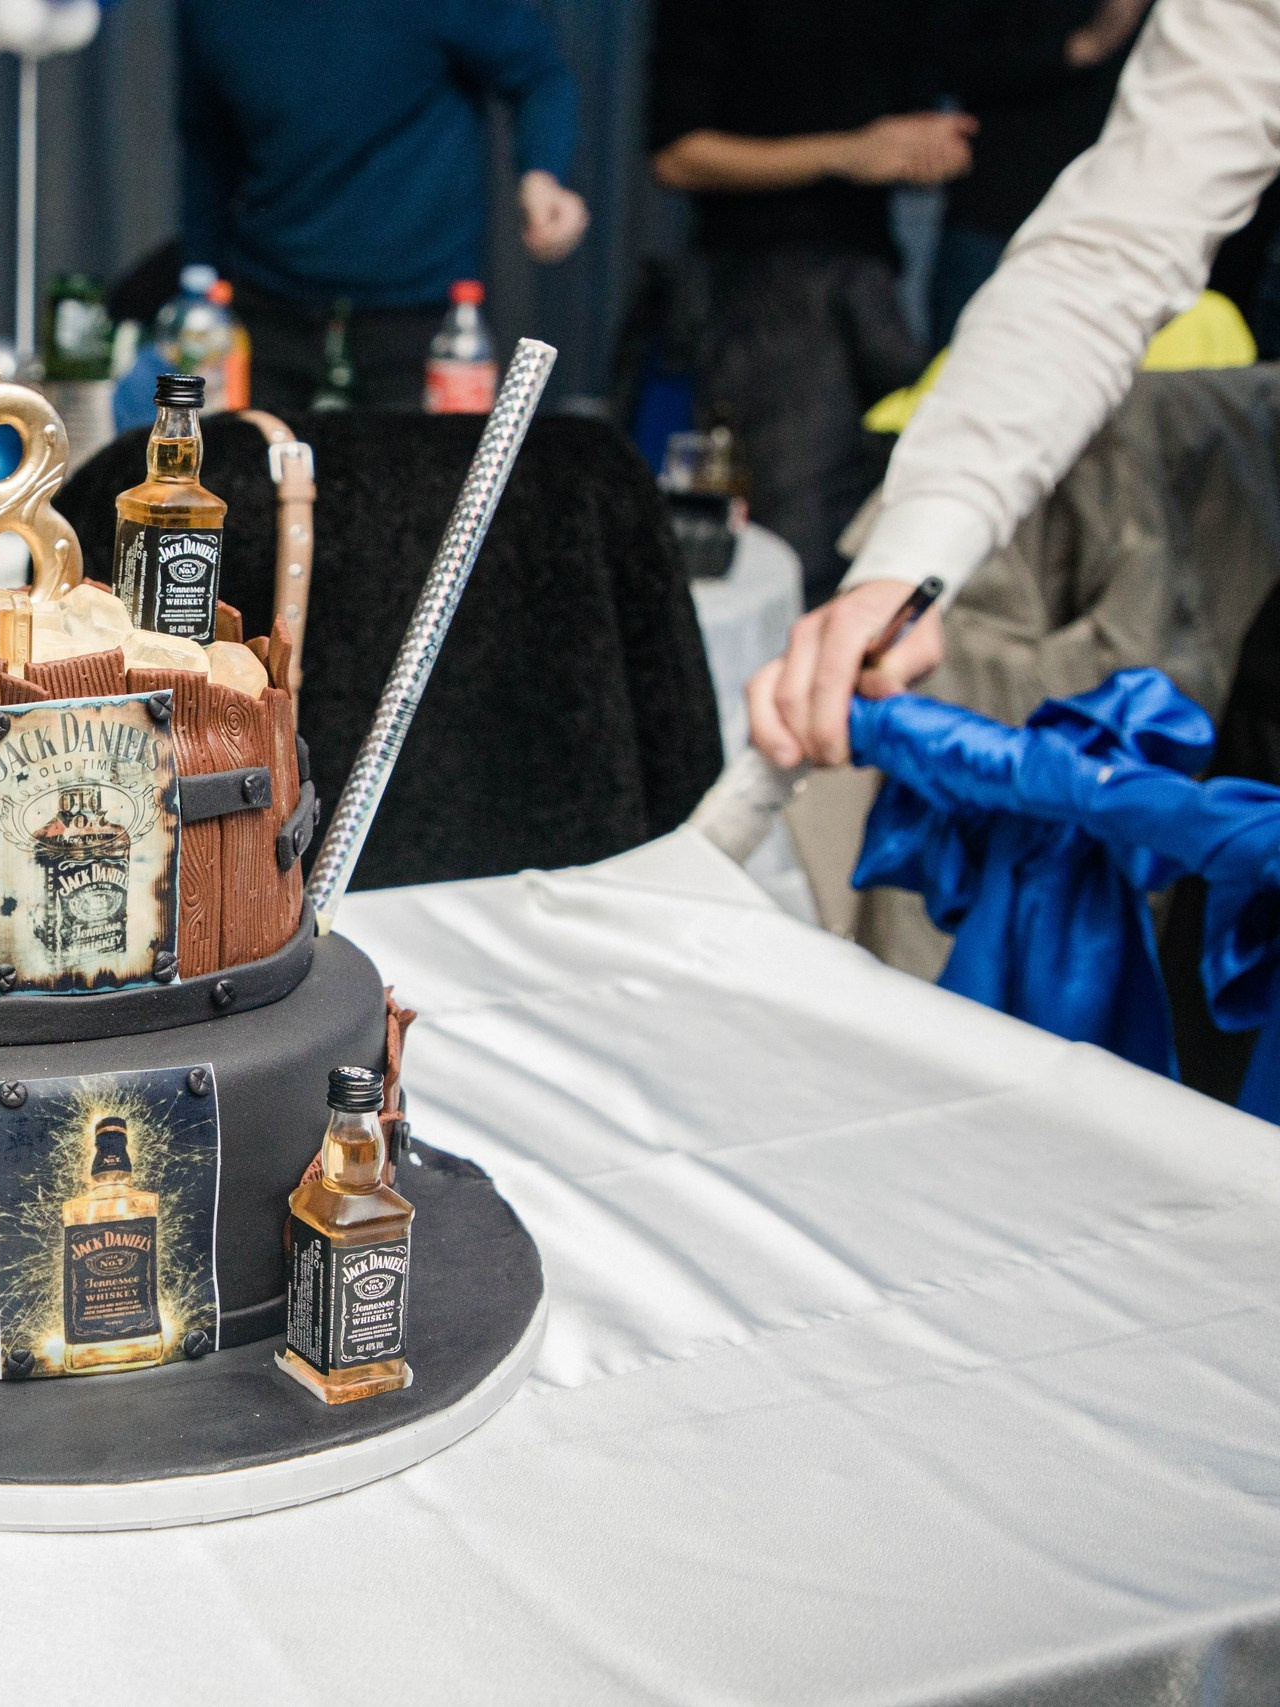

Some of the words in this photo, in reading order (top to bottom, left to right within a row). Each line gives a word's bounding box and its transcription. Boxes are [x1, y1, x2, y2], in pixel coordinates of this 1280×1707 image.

[158, 542, 183, 563] JACK
[183, 538, 219, 564] DANIEL'S
[165, 583, 206, 594] Tennessee
[39, 760, 73, 778] OLD
[82, 758, 117, 772] TIME
[58, 869, 91, 896] JACK
[71, 1236, 103, 1260] JACK
[342, 1259, 369, 1284] JACK
[369, 1253, 407, 1274] DANIEL'S
[84, 1276, 139, 1289] Tennessee
[86, 1289, 138, 1301] WHISKEY
[352, 1300, 395, 1314] Tennessee
[352, 1311, 394, 1326] WHISKEY
